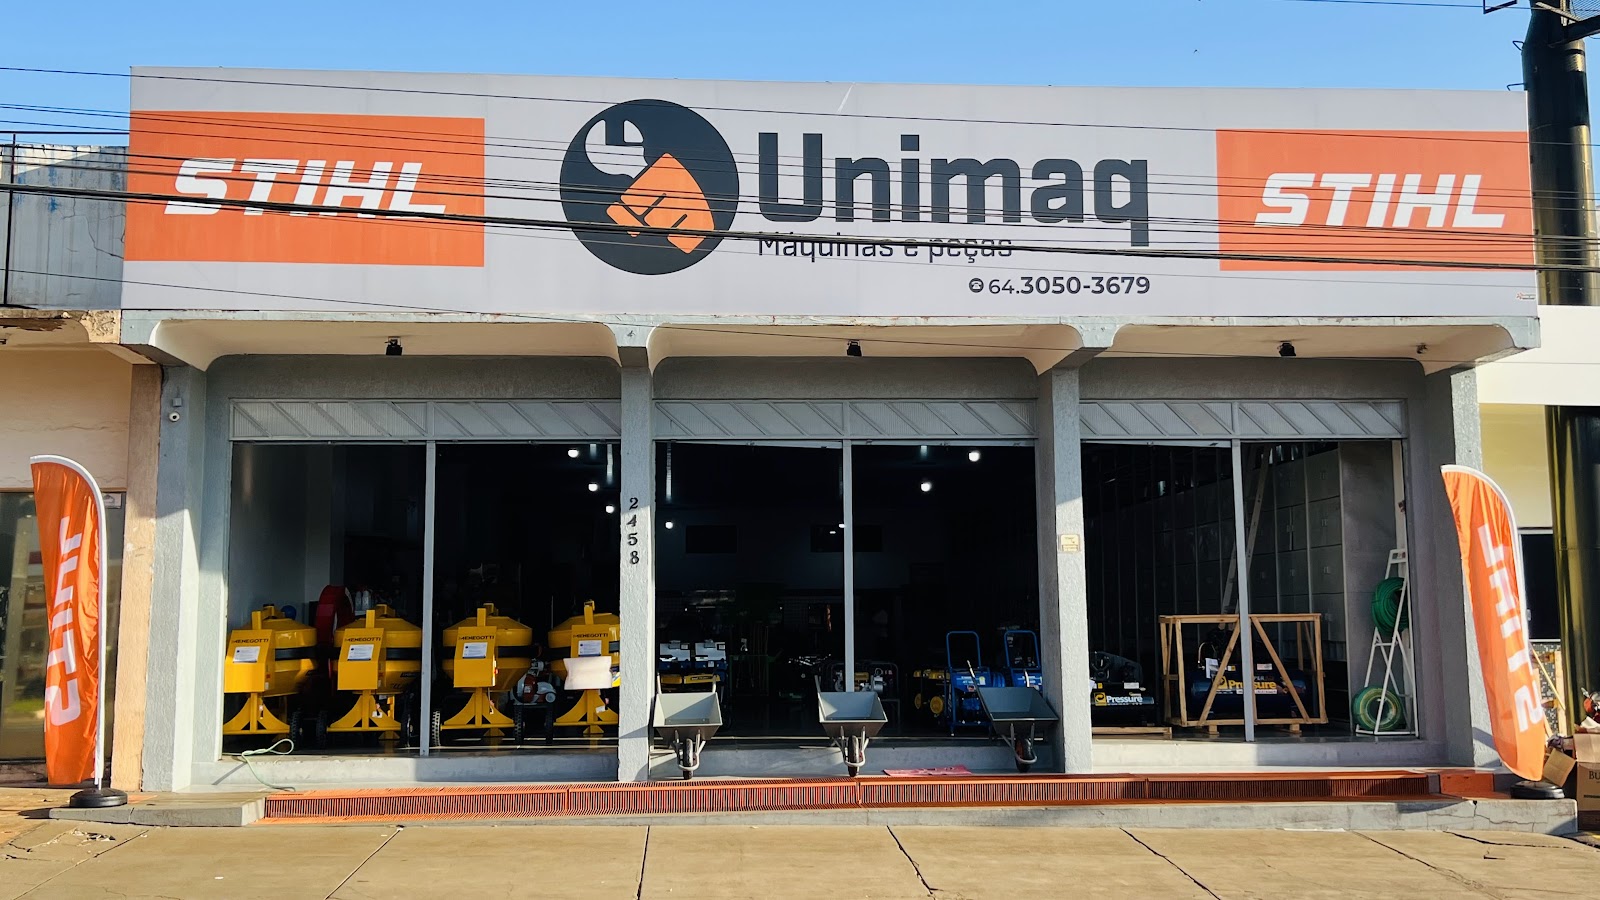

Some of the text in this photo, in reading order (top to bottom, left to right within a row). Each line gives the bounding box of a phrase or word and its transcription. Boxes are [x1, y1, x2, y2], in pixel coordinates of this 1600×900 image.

[164, 157, 447, 219] STIHL
[758, 132, 1149, 247] Unimaq
[1254, 172, 1506, 228] STIHL
[904, 238, 919, 257] e
[929, 238, 1013, 264] peças
[988, 275, 1151, 295] 64.3050-3679
[626, 497, 640, 565] 2458
[1106, 695, 1143, 703] Pressure
